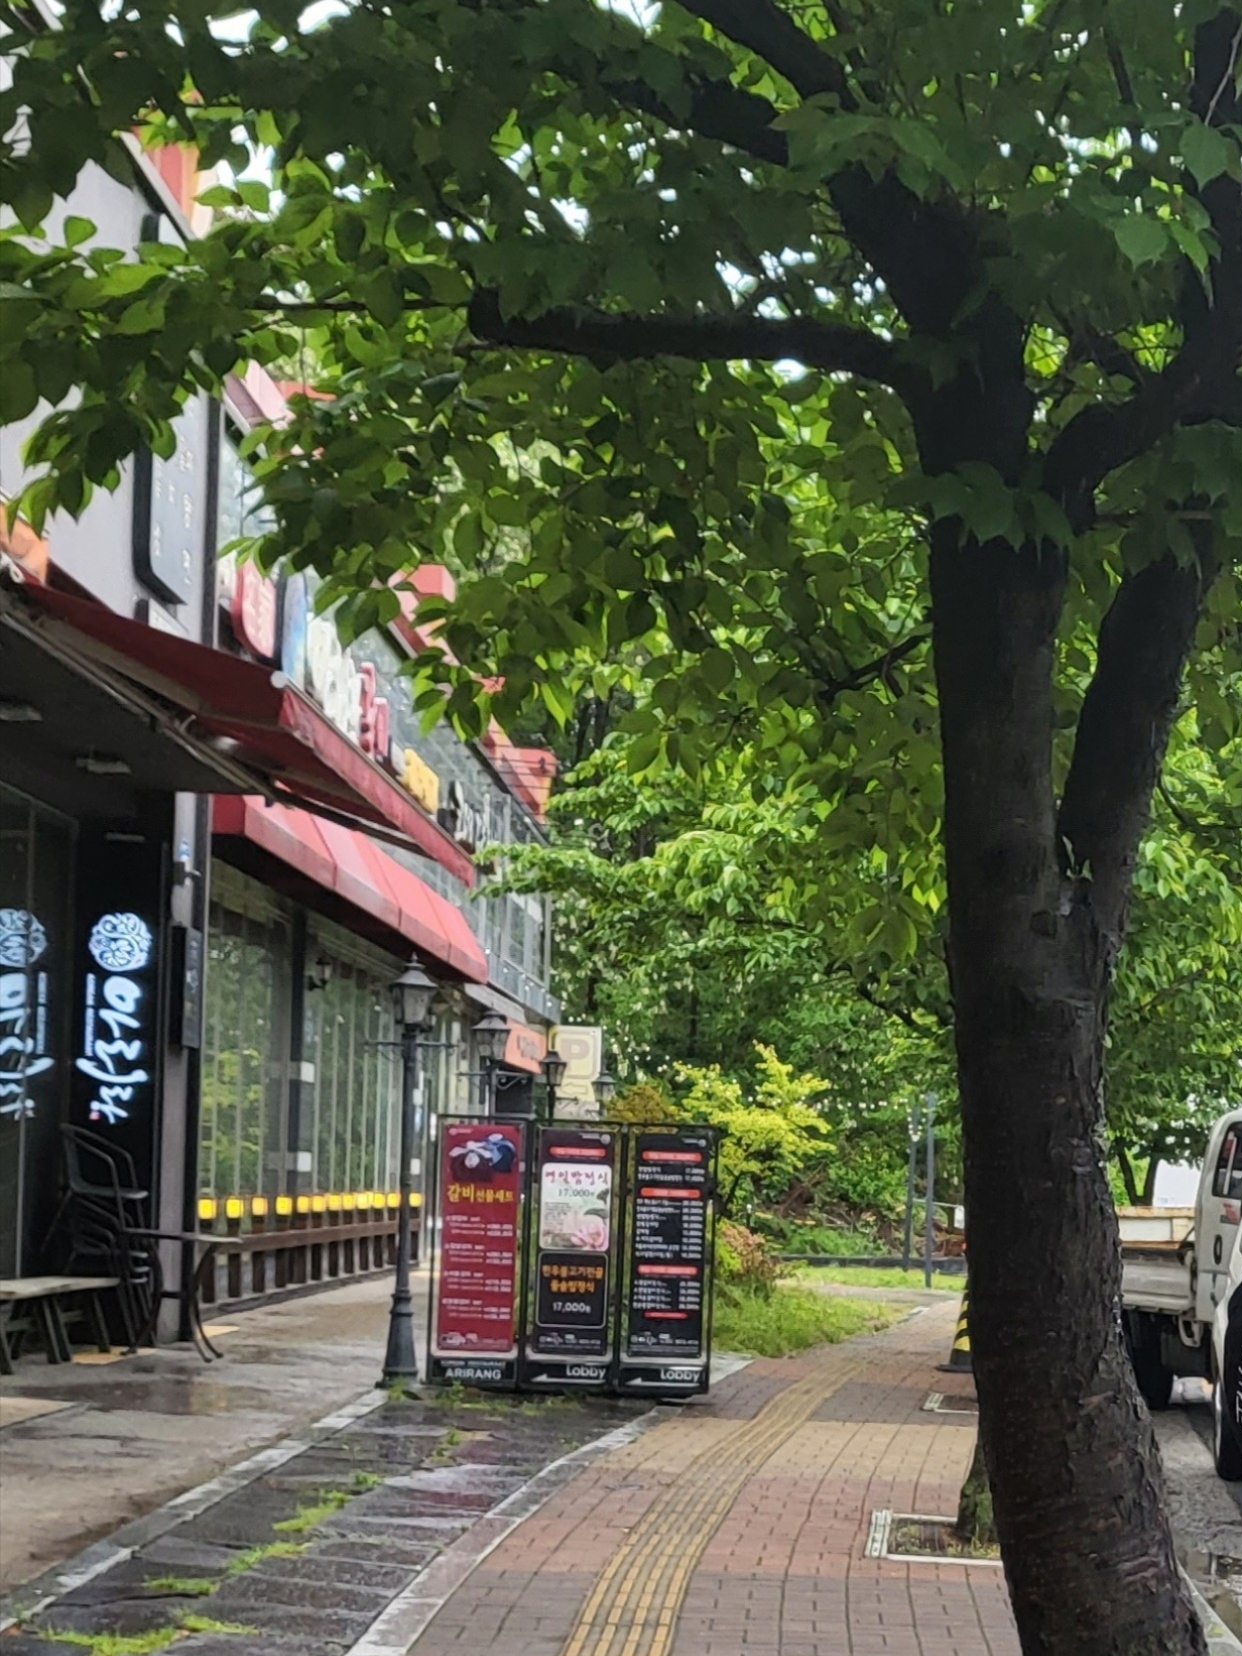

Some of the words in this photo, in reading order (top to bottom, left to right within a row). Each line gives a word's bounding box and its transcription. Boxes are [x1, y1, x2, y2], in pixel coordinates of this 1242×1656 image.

[445, 1367, 502, 1380] ARIRANG
[566, 1365, 606, 1379] Lobby
[660, 1368, 700, 1383] Lobby
